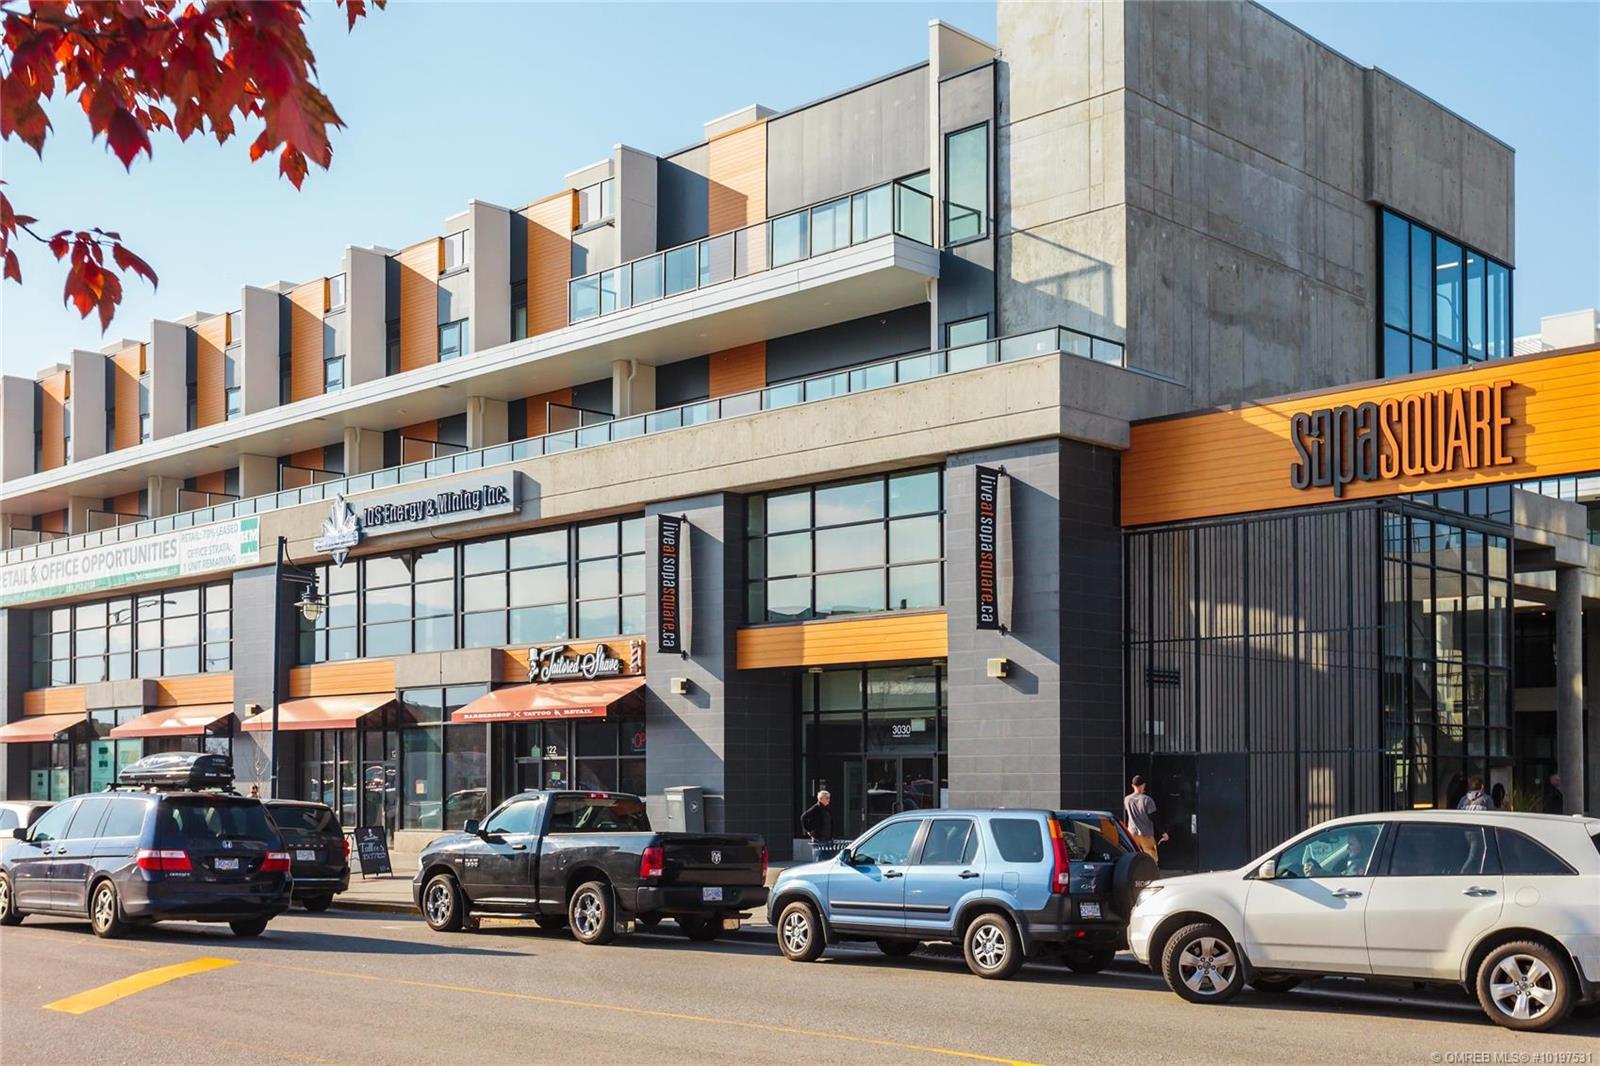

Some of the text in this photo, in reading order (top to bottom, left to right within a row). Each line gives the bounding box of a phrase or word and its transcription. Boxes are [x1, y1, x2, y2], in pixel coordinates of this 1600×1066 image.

[384, 501, 424, 522] Energy
[425, 498, 435, 516] &
[437, 490, 481, 514] Mining
[483, 485, 509, 505] Inc.
[216, 524, 239, 537] LEASED
[187, 545, 207, 559] OFFICE
[980, 474, 996, 622] liveatsopasquare.ca
[0, 567, 30, 588] ETAIL
[31, 563, 39, 584] &
[40, 558, 79, 581] OFFICE
[81, 539, 177, 574] OPPORTUNITIES
[202, 555, 237, 570] REMAINING
[661, 522, 678, 647] liveatsopasquare.ca
[540, 644, 621, 681] Tailored Shave
[463, 711, 511, 719] BARBERSHOP
[892, 724, 911, 735] 3030
